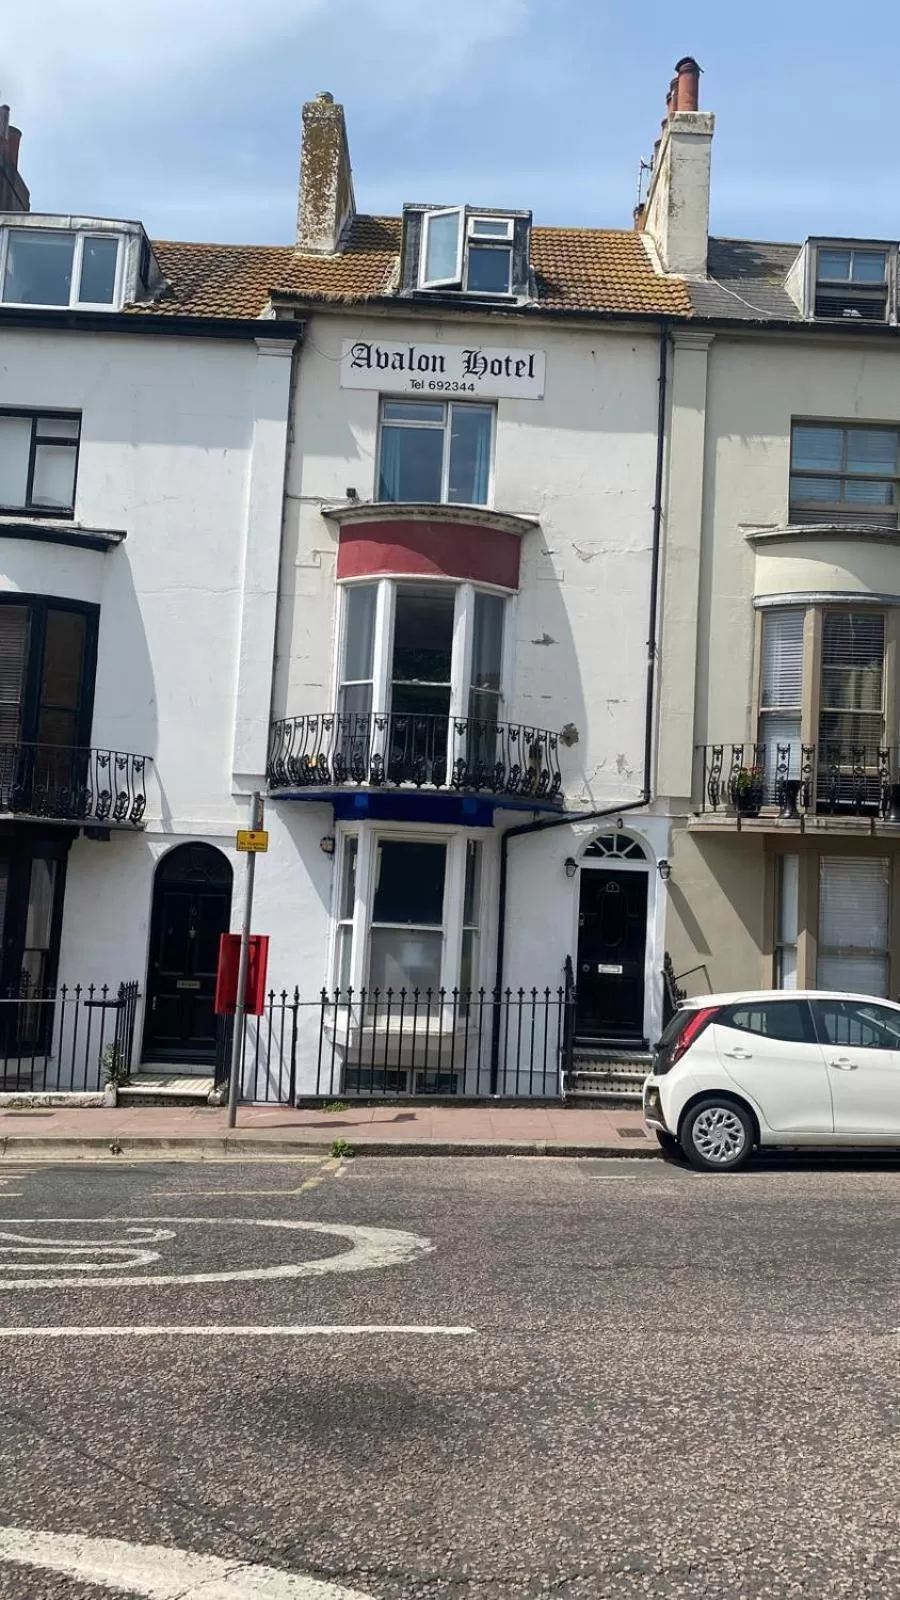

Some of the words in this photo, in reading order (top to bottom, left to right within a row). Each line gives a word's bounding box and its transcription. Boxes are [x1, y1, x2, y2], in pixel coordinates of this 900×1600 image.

[350, 342, 446, 373] Avalon
[461, 349, 536, 380] Hotel
[409, 379, 424, 389] Tel
[428, 380, 475, 392] 692344
